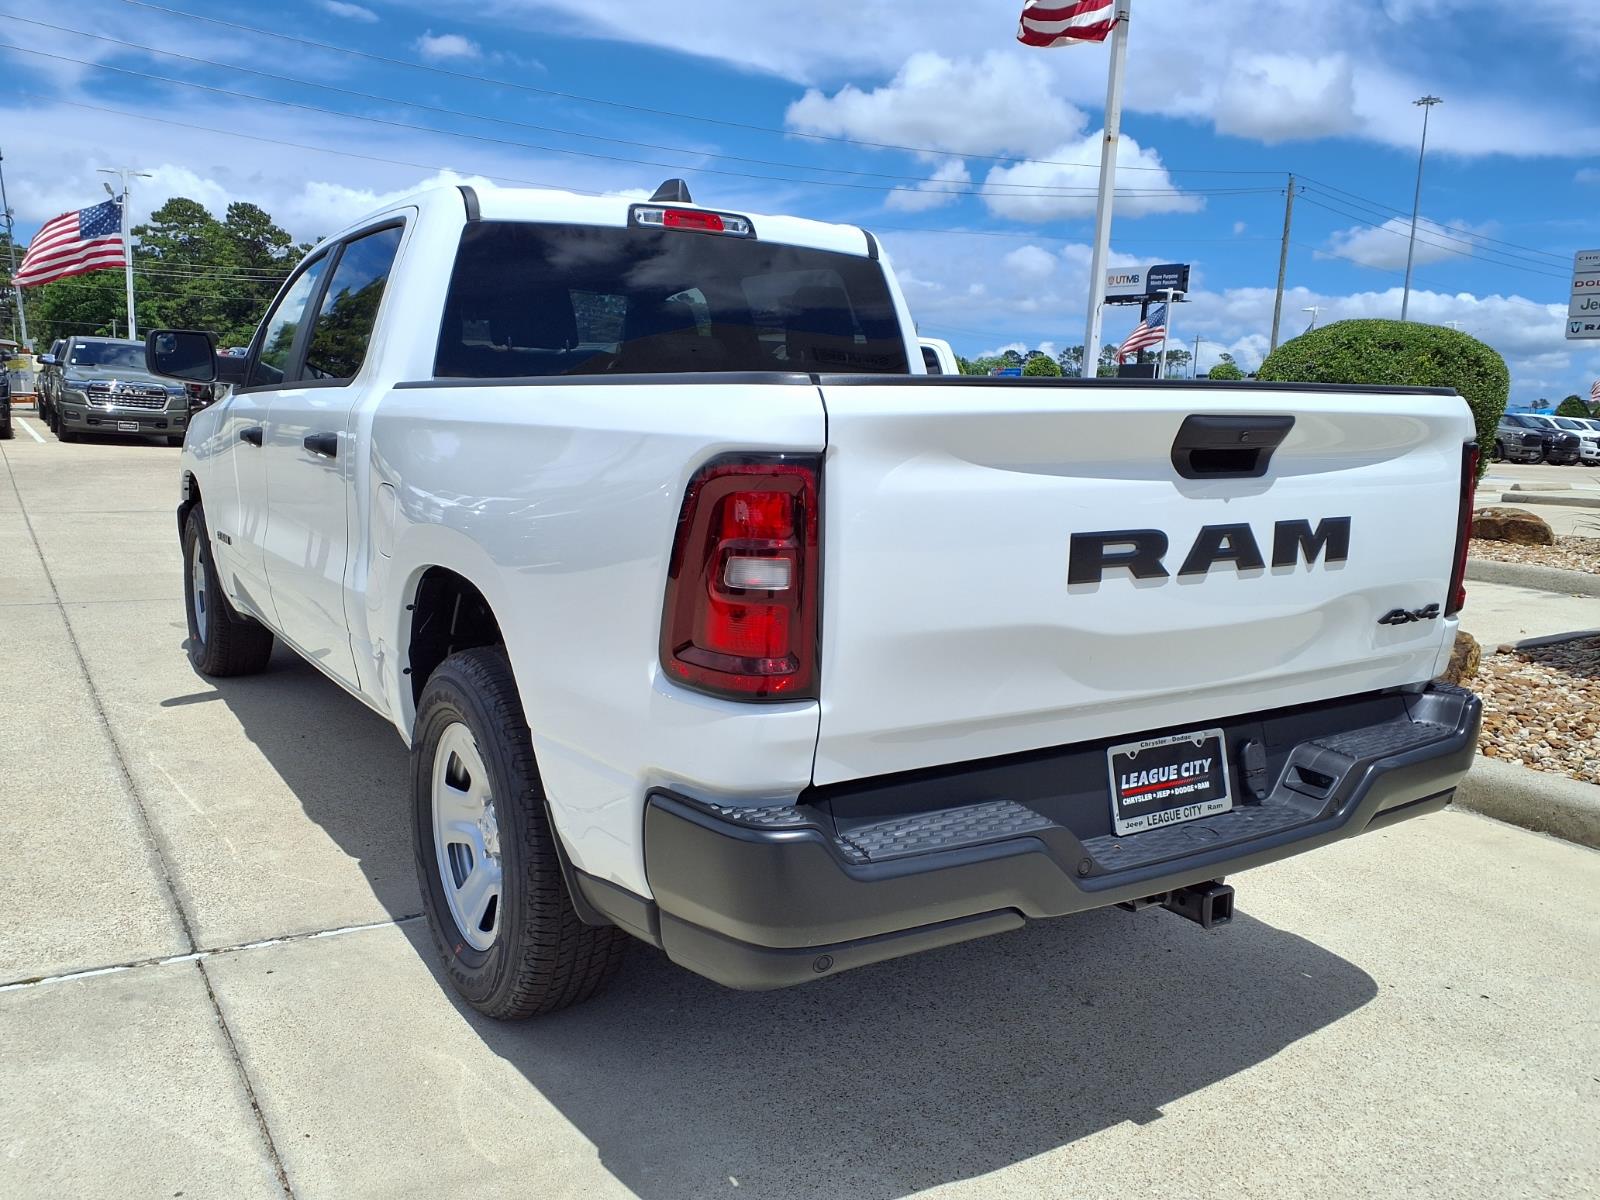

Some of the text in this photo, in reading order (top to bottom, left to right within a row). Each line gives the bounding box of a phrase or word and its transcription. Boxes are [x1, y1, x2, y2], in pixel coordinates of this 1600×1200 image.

[1116, 274, 1140, 284] UTMB
[1581, 298, 1600, 310] Je
[1067, 515, 1352, 585] RAM
[1140, 735, 1192, 749] Chrysler Dodge
[1121, 757, 1213, 790] LEAGUE CITY
[1123, 781, 1209, 805] CHRYSLER JEEP DODGE RAM
[1125, 803, 1223, 829] Jeep LEAGUE CITY Ram
